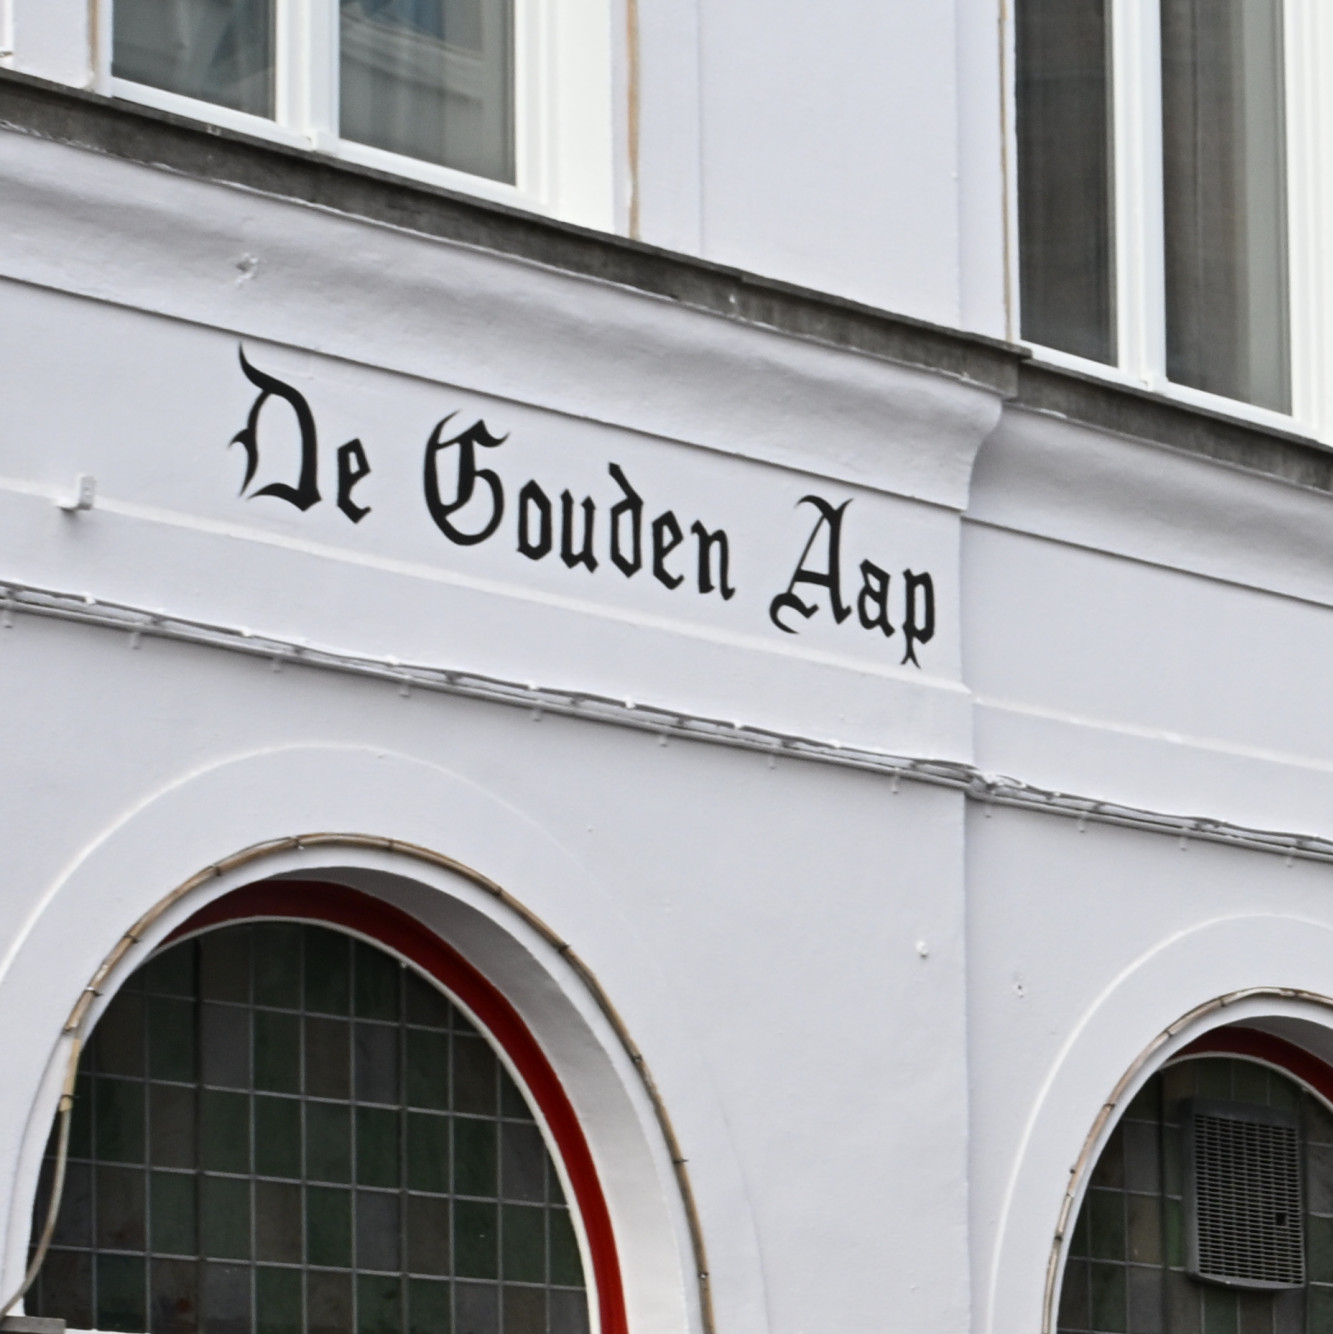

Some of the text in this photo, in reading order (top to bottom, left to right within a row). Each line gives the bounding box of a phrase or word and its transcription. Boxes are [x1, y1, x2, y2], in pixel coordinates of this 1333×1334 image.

[229, 342, 935, 668] De Gouden Aap
